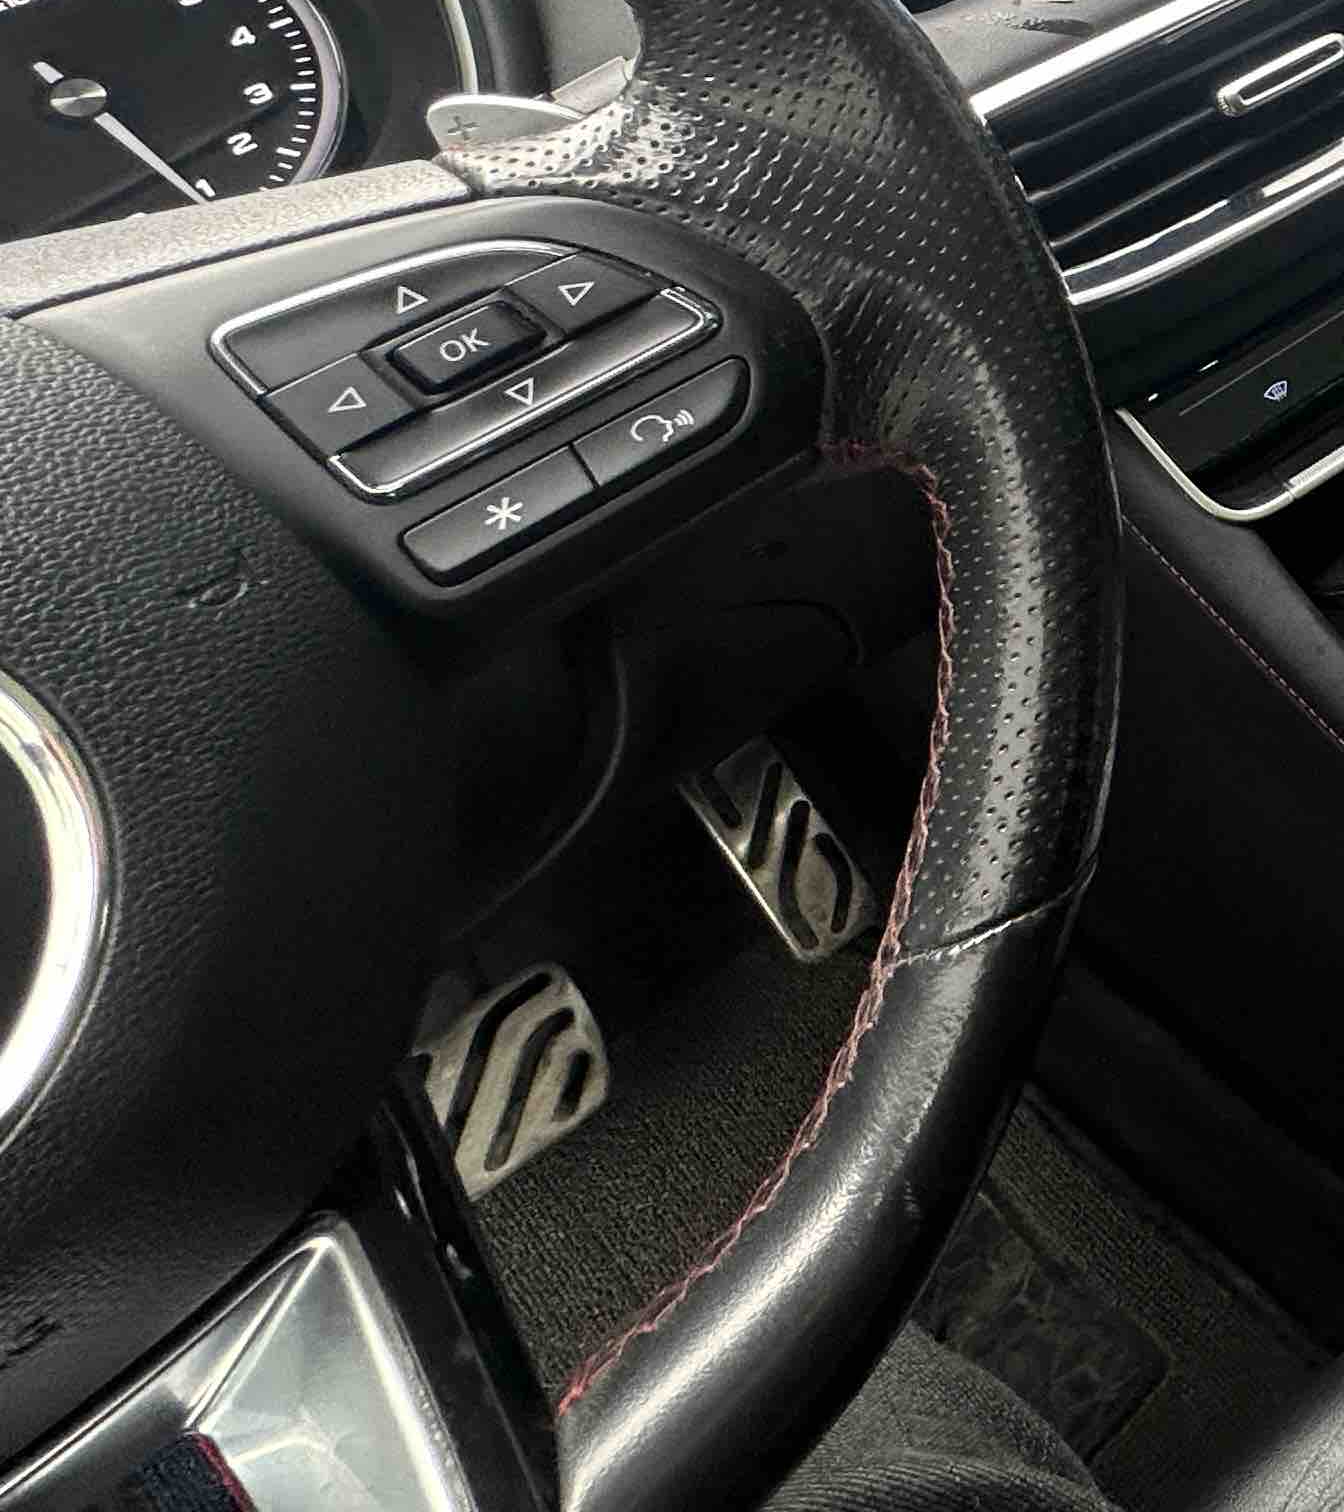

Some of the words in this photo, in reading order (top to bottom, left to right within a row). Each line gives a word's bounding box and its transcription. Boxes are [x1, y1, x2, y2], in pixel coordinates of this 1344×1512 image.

[231, 25, 256, 47] 4
[244, 82, 274, 105] 3
[228, 132, 259, 156] 2
[196, 178, 216, 197] 1
[440, 327, 490, 362] OK
